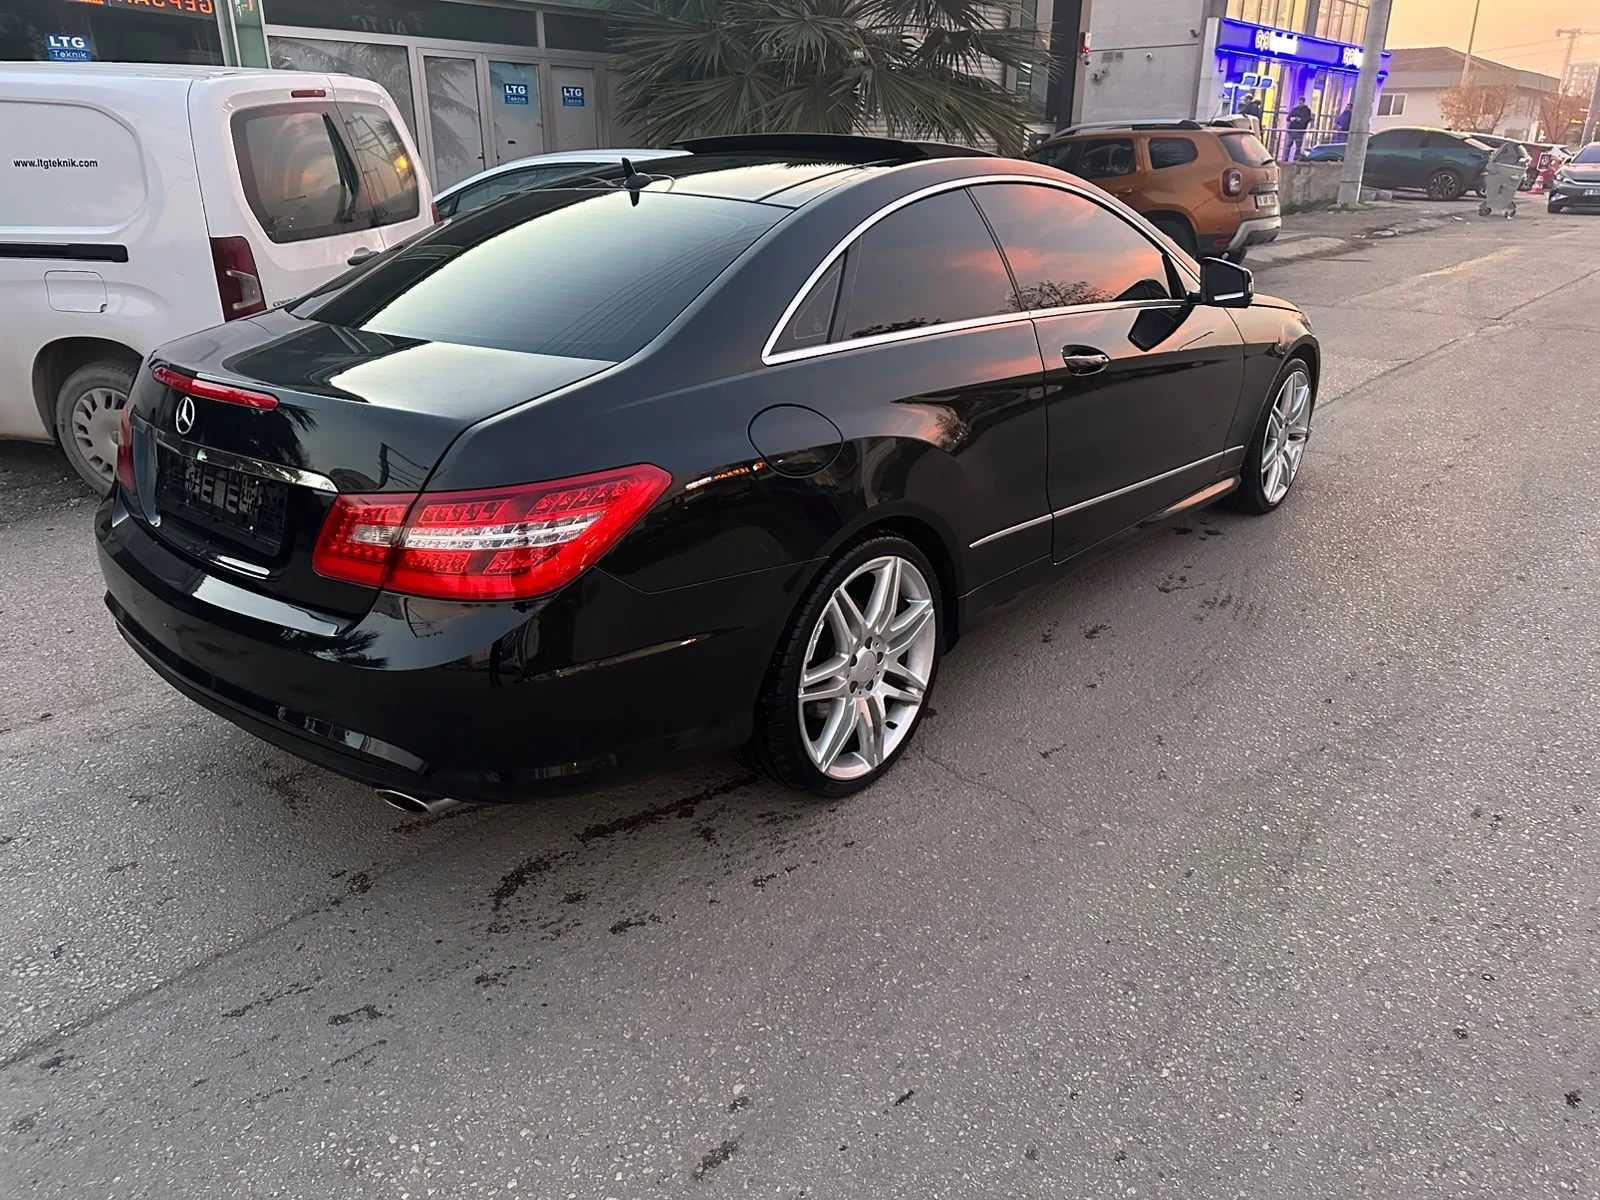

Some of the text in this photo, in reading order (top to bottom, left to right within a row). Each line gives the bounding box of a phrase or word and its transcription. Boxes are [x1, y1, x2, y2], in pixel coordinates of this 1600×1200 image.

[49, 35, 86, 49] LTG
[53, 50, 88, 59] Teknik
[505, 85, 526, 94] LTG
[563, 88, 582, 96] LTG
[13, 158, 98, 169] www.ltgteknik.com
